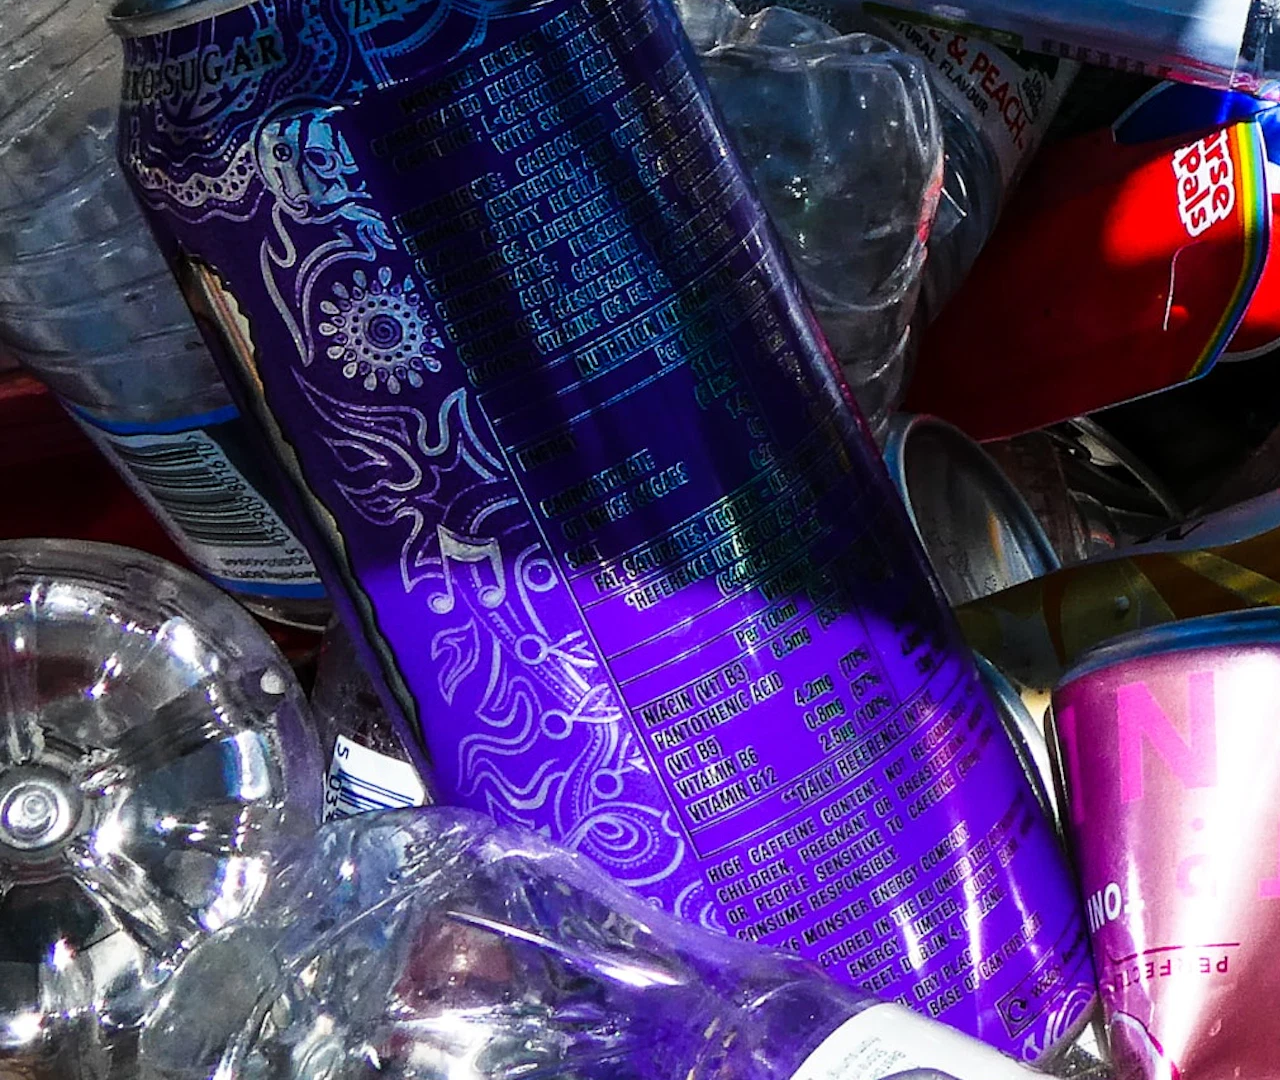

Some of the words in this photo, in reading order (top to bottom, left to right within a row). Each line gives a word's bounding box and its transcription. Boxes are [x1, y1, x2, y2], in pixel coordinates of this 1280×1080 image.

[156, 34, 286, 104] SUGAR
[938, 59, 989, 117] FLAVOUR
[946, 34, 968, 66] &
[1178, 144, 1211, 229] pals
[731, 620, 763, 649] Per
[756, 599, 803, 636] 100ml
[639, 689, 694, 729] NIACIN
[689, 673, 725, 705] (VIT
[719, 659, 752, 689] B3)
[769, 625, 815, 661] 8.5mg
[653, 692, 750, 753] PANTOTHENIC
[746, 671, 785, 704] ACID
[664, 748, 699, 778] (VIT
[693, 735, 723, 763] B5)
[790, 672, 837, 708] 4.2mg
[674, 756, 739, 801] VITAMIN
[735, 745, 760, 771] B6
[802, 695, 847, 731] 0.8mg
[832, 718, 909, 778] REFERENCE
[686, 780, 752, 825] VITAMIN
[748, 764, 780, 794] B12
[705, 852, 747, 886] HIGH
[744, 813, 823, 867] CAFFEINE
[884, 758, 915, 787] NOT
[717, 854, 797, 906] CHILDREN,
[795, 812, 873, 865] PREGNANT
[872, 792, 897, 817] OR
[724, 899, 753, 927] OR
[751, 870, 809, 912] PEOPLE
[810, 827, 889, 882] SENSITIVE
[883, 811, 908, 836] TO
[902, 773, 963, 822] CAFFEINE
[800, 897, 872, 948] MONSTER
[867, 864, 926, 909] ENERGY
[916, 821, 977, 872] COMPANY
[734, 898, 806, 947] CONSUME
[802, 845, 904, 914] RESPONSIBLY.
[871, 913, 894, 937] IN
[889, 897, 920, 925] THE
[914, 882, 940, 908] EU
[844, 934, 903, 978] ENERGY
[910, 975, 943, 1004] DRY
[925, 983, 965, 1017] BASE
[975, 949, 1008, 980] CAN
